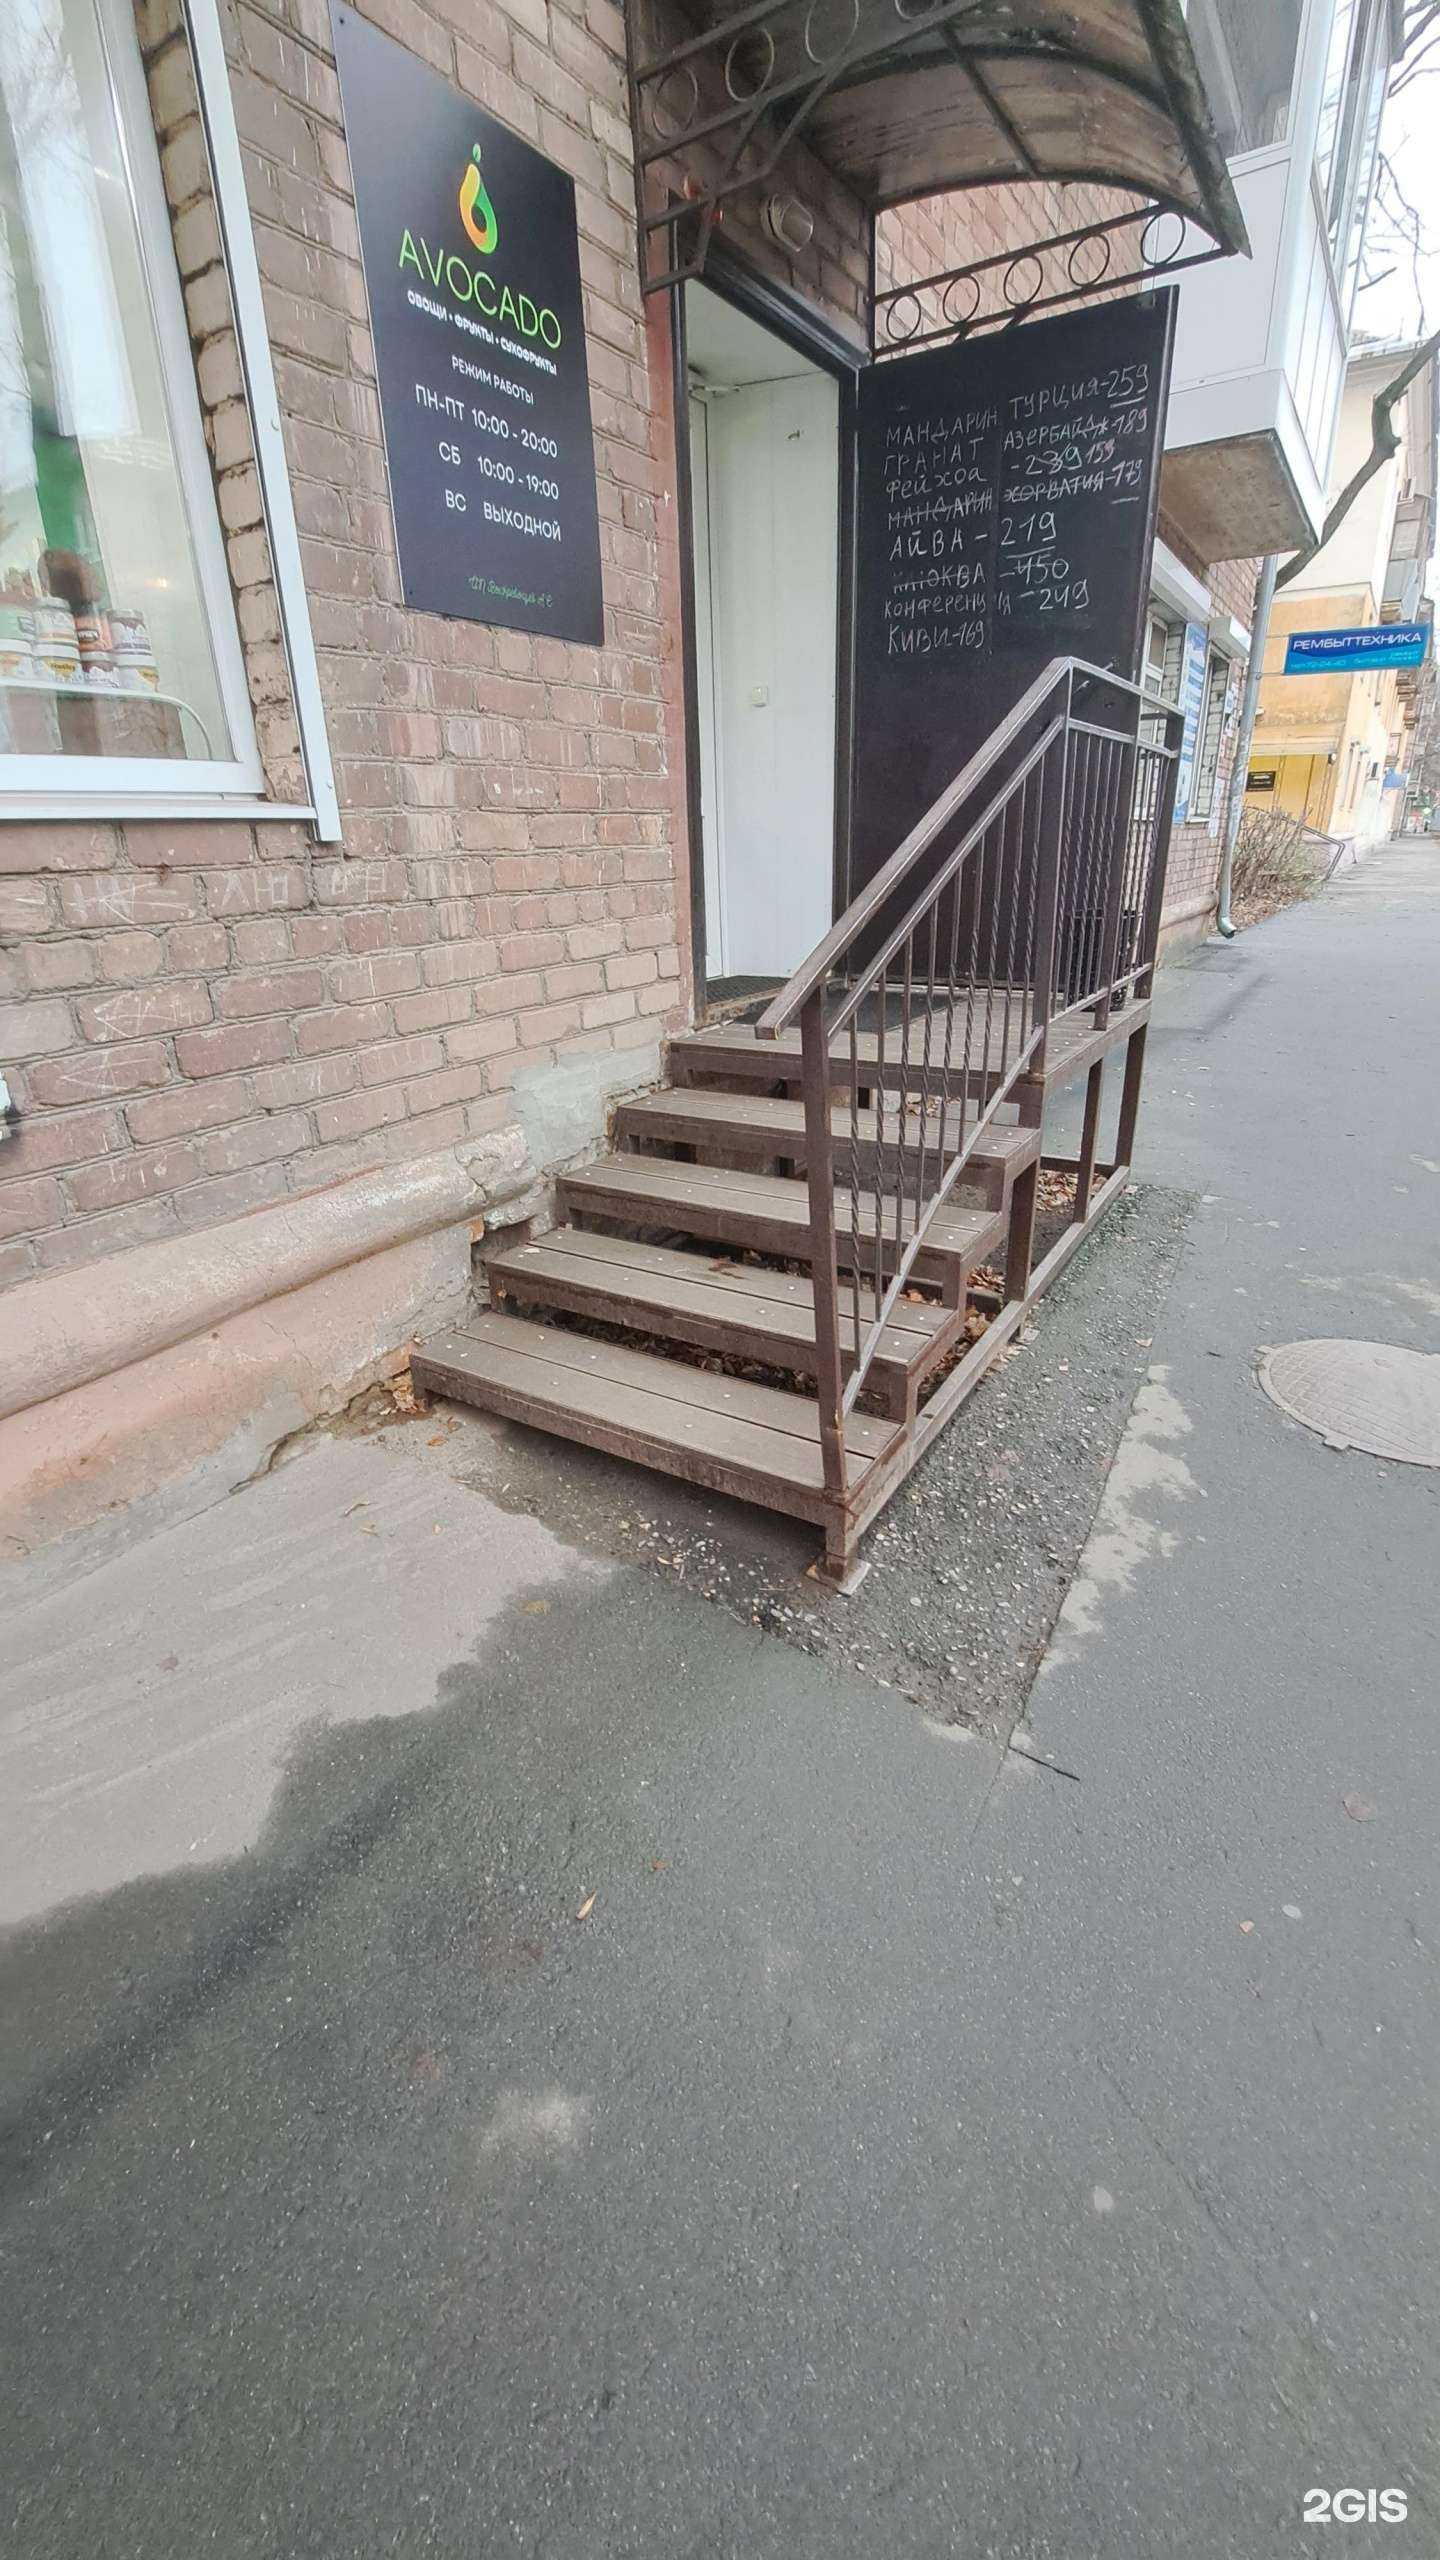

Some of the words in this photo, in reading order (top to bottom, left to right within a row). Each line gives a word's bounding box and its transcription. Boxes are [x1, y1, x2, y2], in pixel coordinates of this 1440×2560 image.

[398, 229, 563, 350] AVOCADO
[406, 289, 448, 321] ОВОЩИ
[454, 313, 494, 345] ФРУКТЫ
[499, 336, 558, 376] СУХОФРУКТЫ
[451, 355, 492, 385] РЕЖИМ
[493, 373, 534, 405] РАБОТЫ
[415, 383, 464, 421] ПН-ПТ
[471, 407, 509, 439] 10:00
[520, 428, 558, 458] 20:00
[438, 440, 462, 466] СБ
[477, 455, 515, 485] 10:00
[525, 473, 559, 501] 19:00
[444, 488, 467, 512] ВС
[483, 501, 562, 542] ВЫХОДНОЙ
[1292, 632, 1422, 651] РЕМБЫТТЕХНИКА
